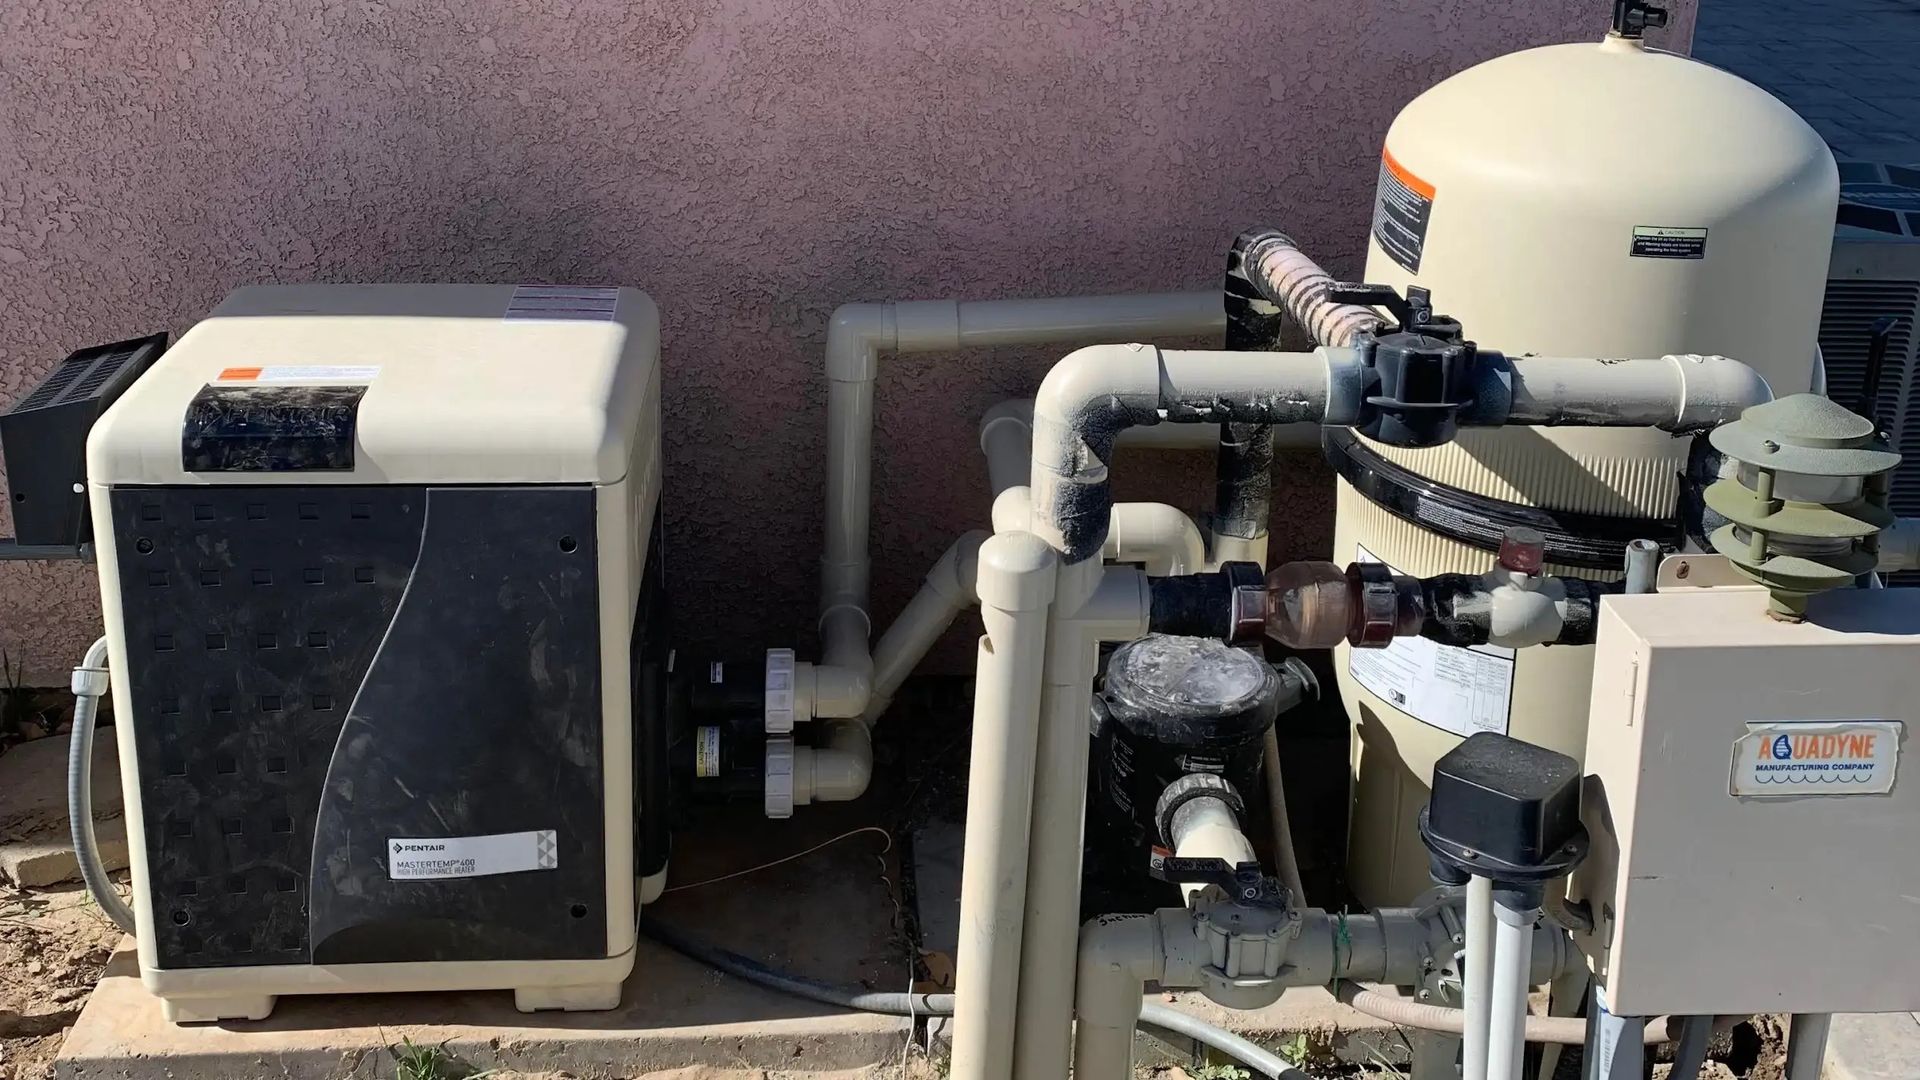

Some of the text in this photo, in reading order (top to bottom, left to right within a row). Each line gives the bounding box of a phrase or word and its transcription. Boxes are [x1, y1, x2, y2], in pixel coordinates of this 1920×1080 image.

[1758, 734, 1877, 760] AQUADYNE
[1756, 763, 1875, 772] MANUFACTURING COMPANY
[404, 844, 445, 852] PENTAIR
[411, 867, 453, 876] PERFORMANCE
[454, 866, 475, 875] HEATER
